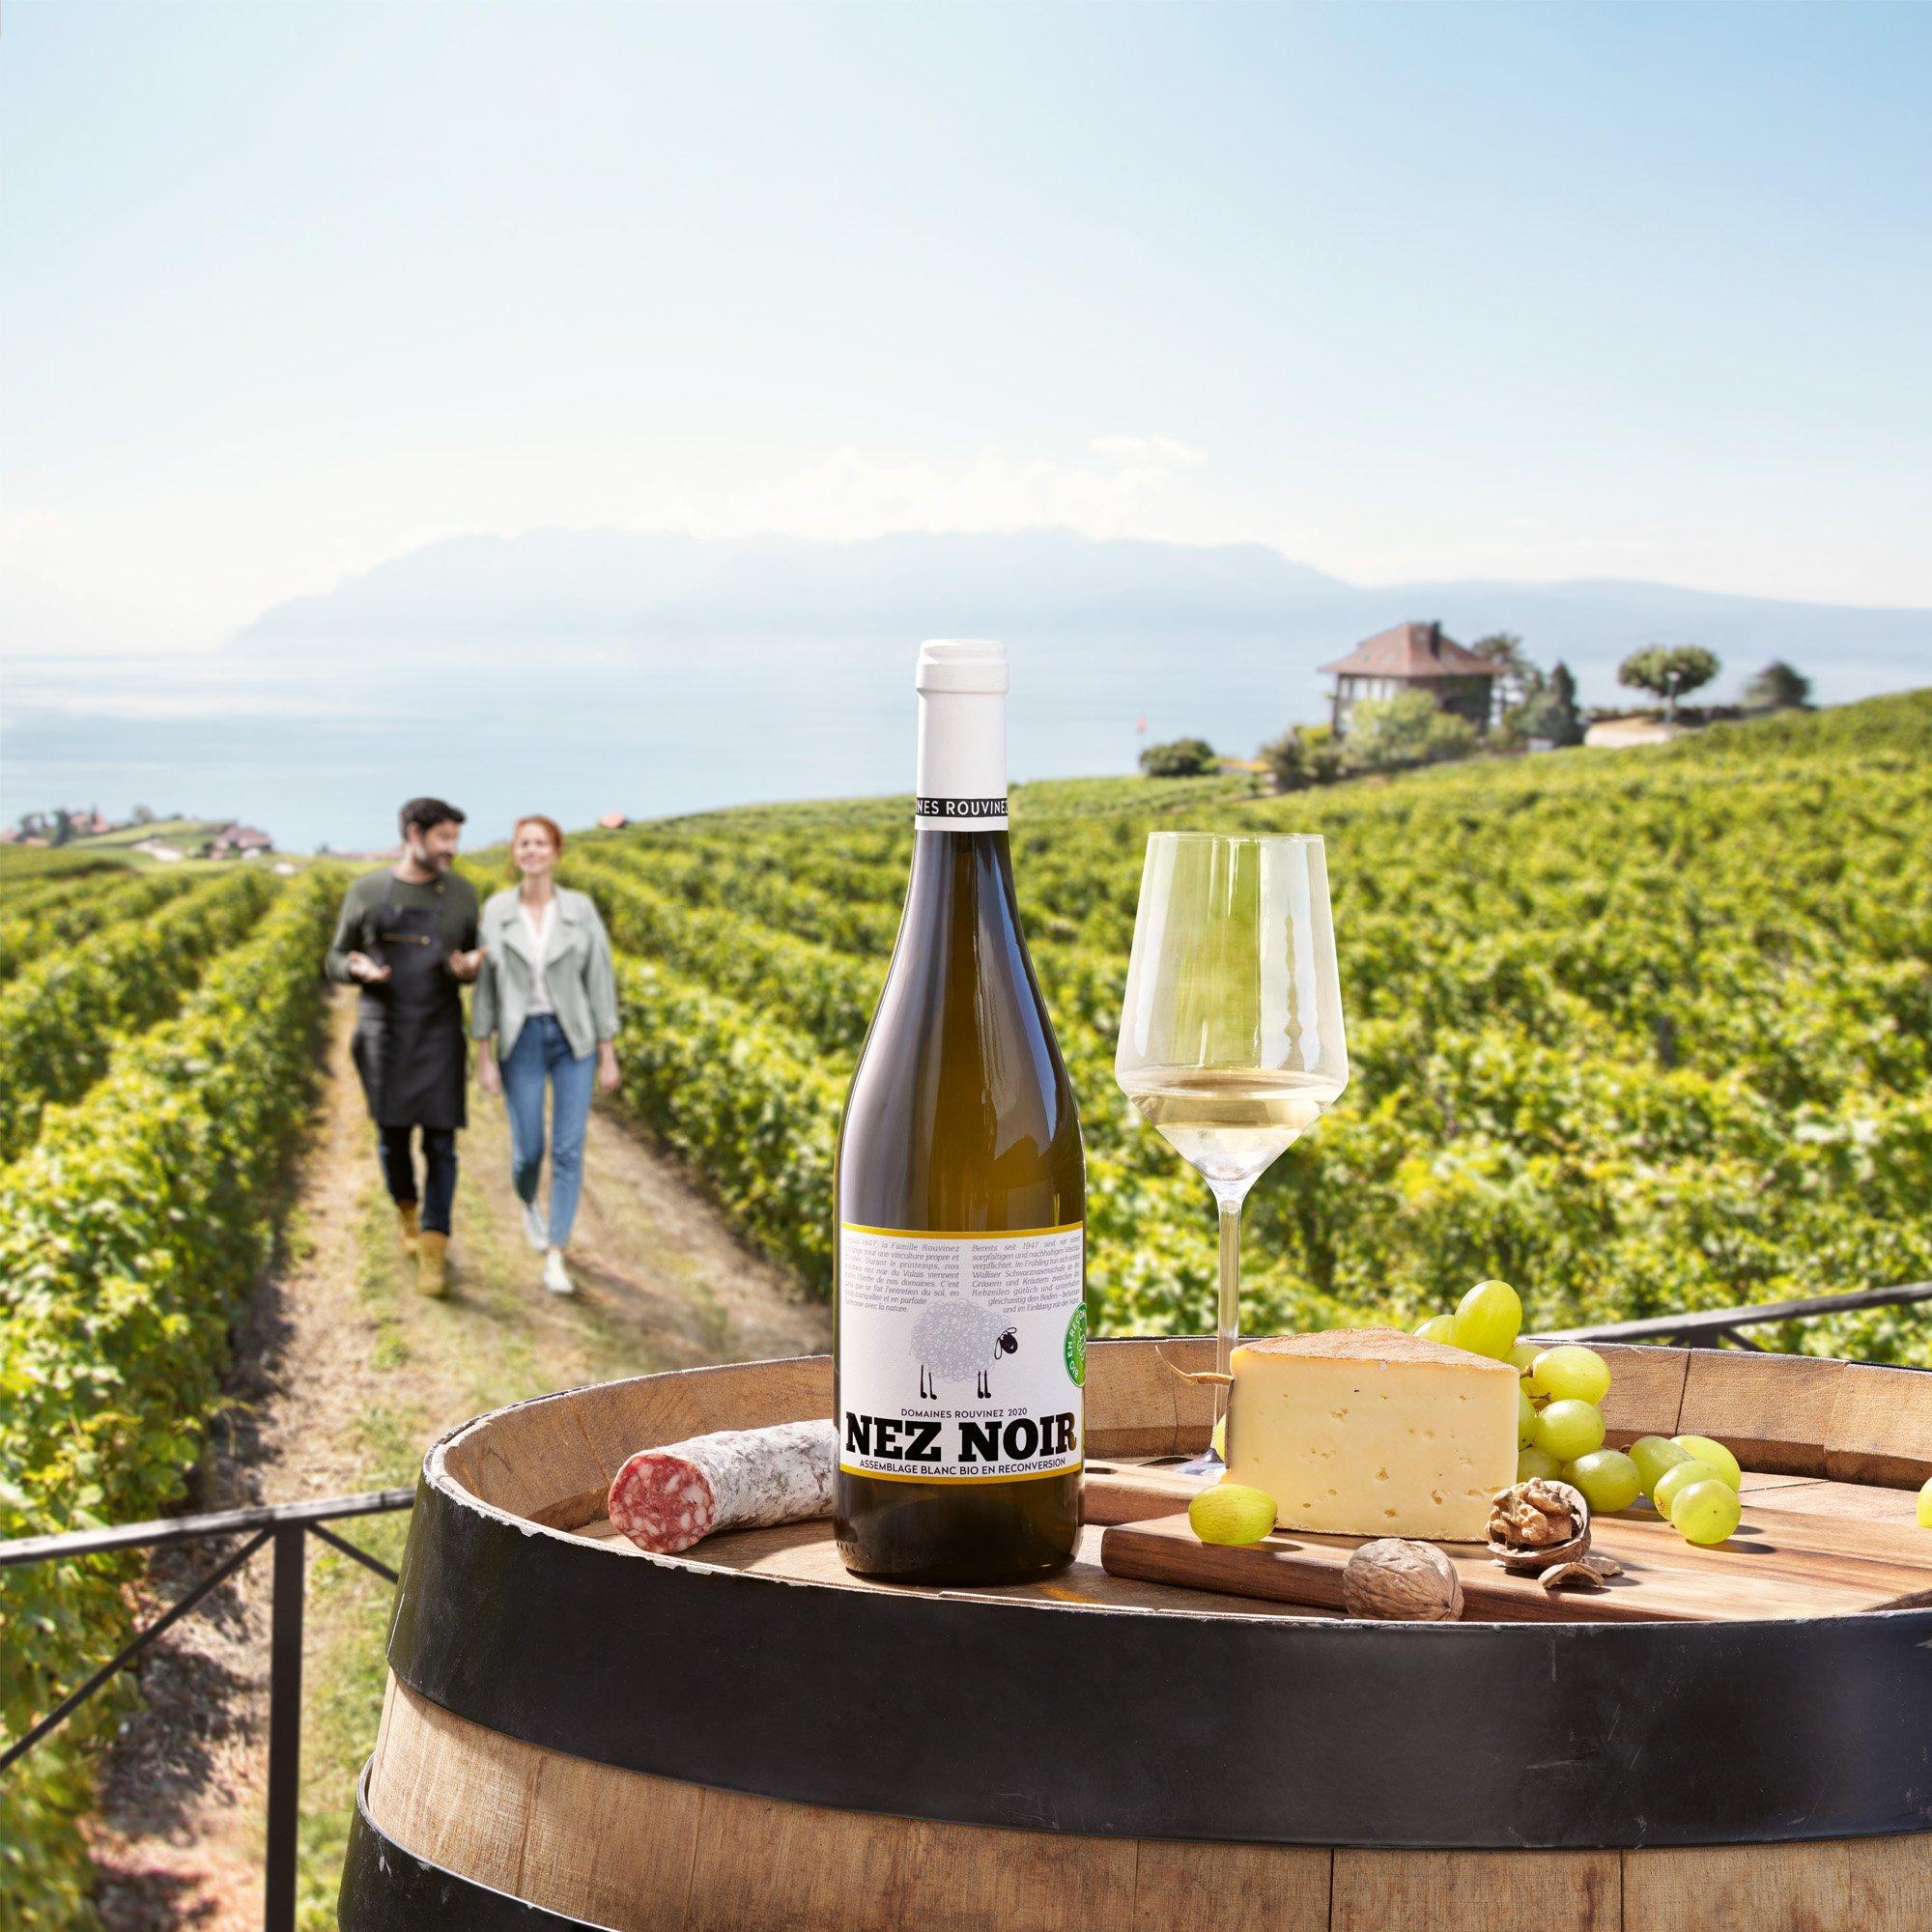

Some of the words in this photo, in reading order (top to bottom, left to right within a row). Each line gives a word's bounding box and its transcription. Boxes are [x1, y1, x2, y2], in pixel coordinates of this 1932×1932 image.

[891, 1251, 923, 1260] viticulture
[1025, 1258, 1049, 1266] Frühling
[988, 1296, 1026, 1306] gleichzeitig
[1040, 1293, 1058, 1301] Boden
[1067, 1342, 1072, 1357] EN
[901, 1408, 952, 1419] DOMAINES
[955, 1409, 1004, 1419] ROUVINEZ
[1008, 1407, 1027, 1417] 2020
[846, 1411, 942, 1462] NEZ
[958, 1411, 1077, 1463] NOIR
[860, 1460, 918, 1474] ASSEMBLAGE
[921, 1465, 956, 1475] BLANC
[960, 1465, 978, 1475] BIO
[982, 1465, 995, 1474] EN
[999, 1459, 1065, 1474] RECONVERSION
